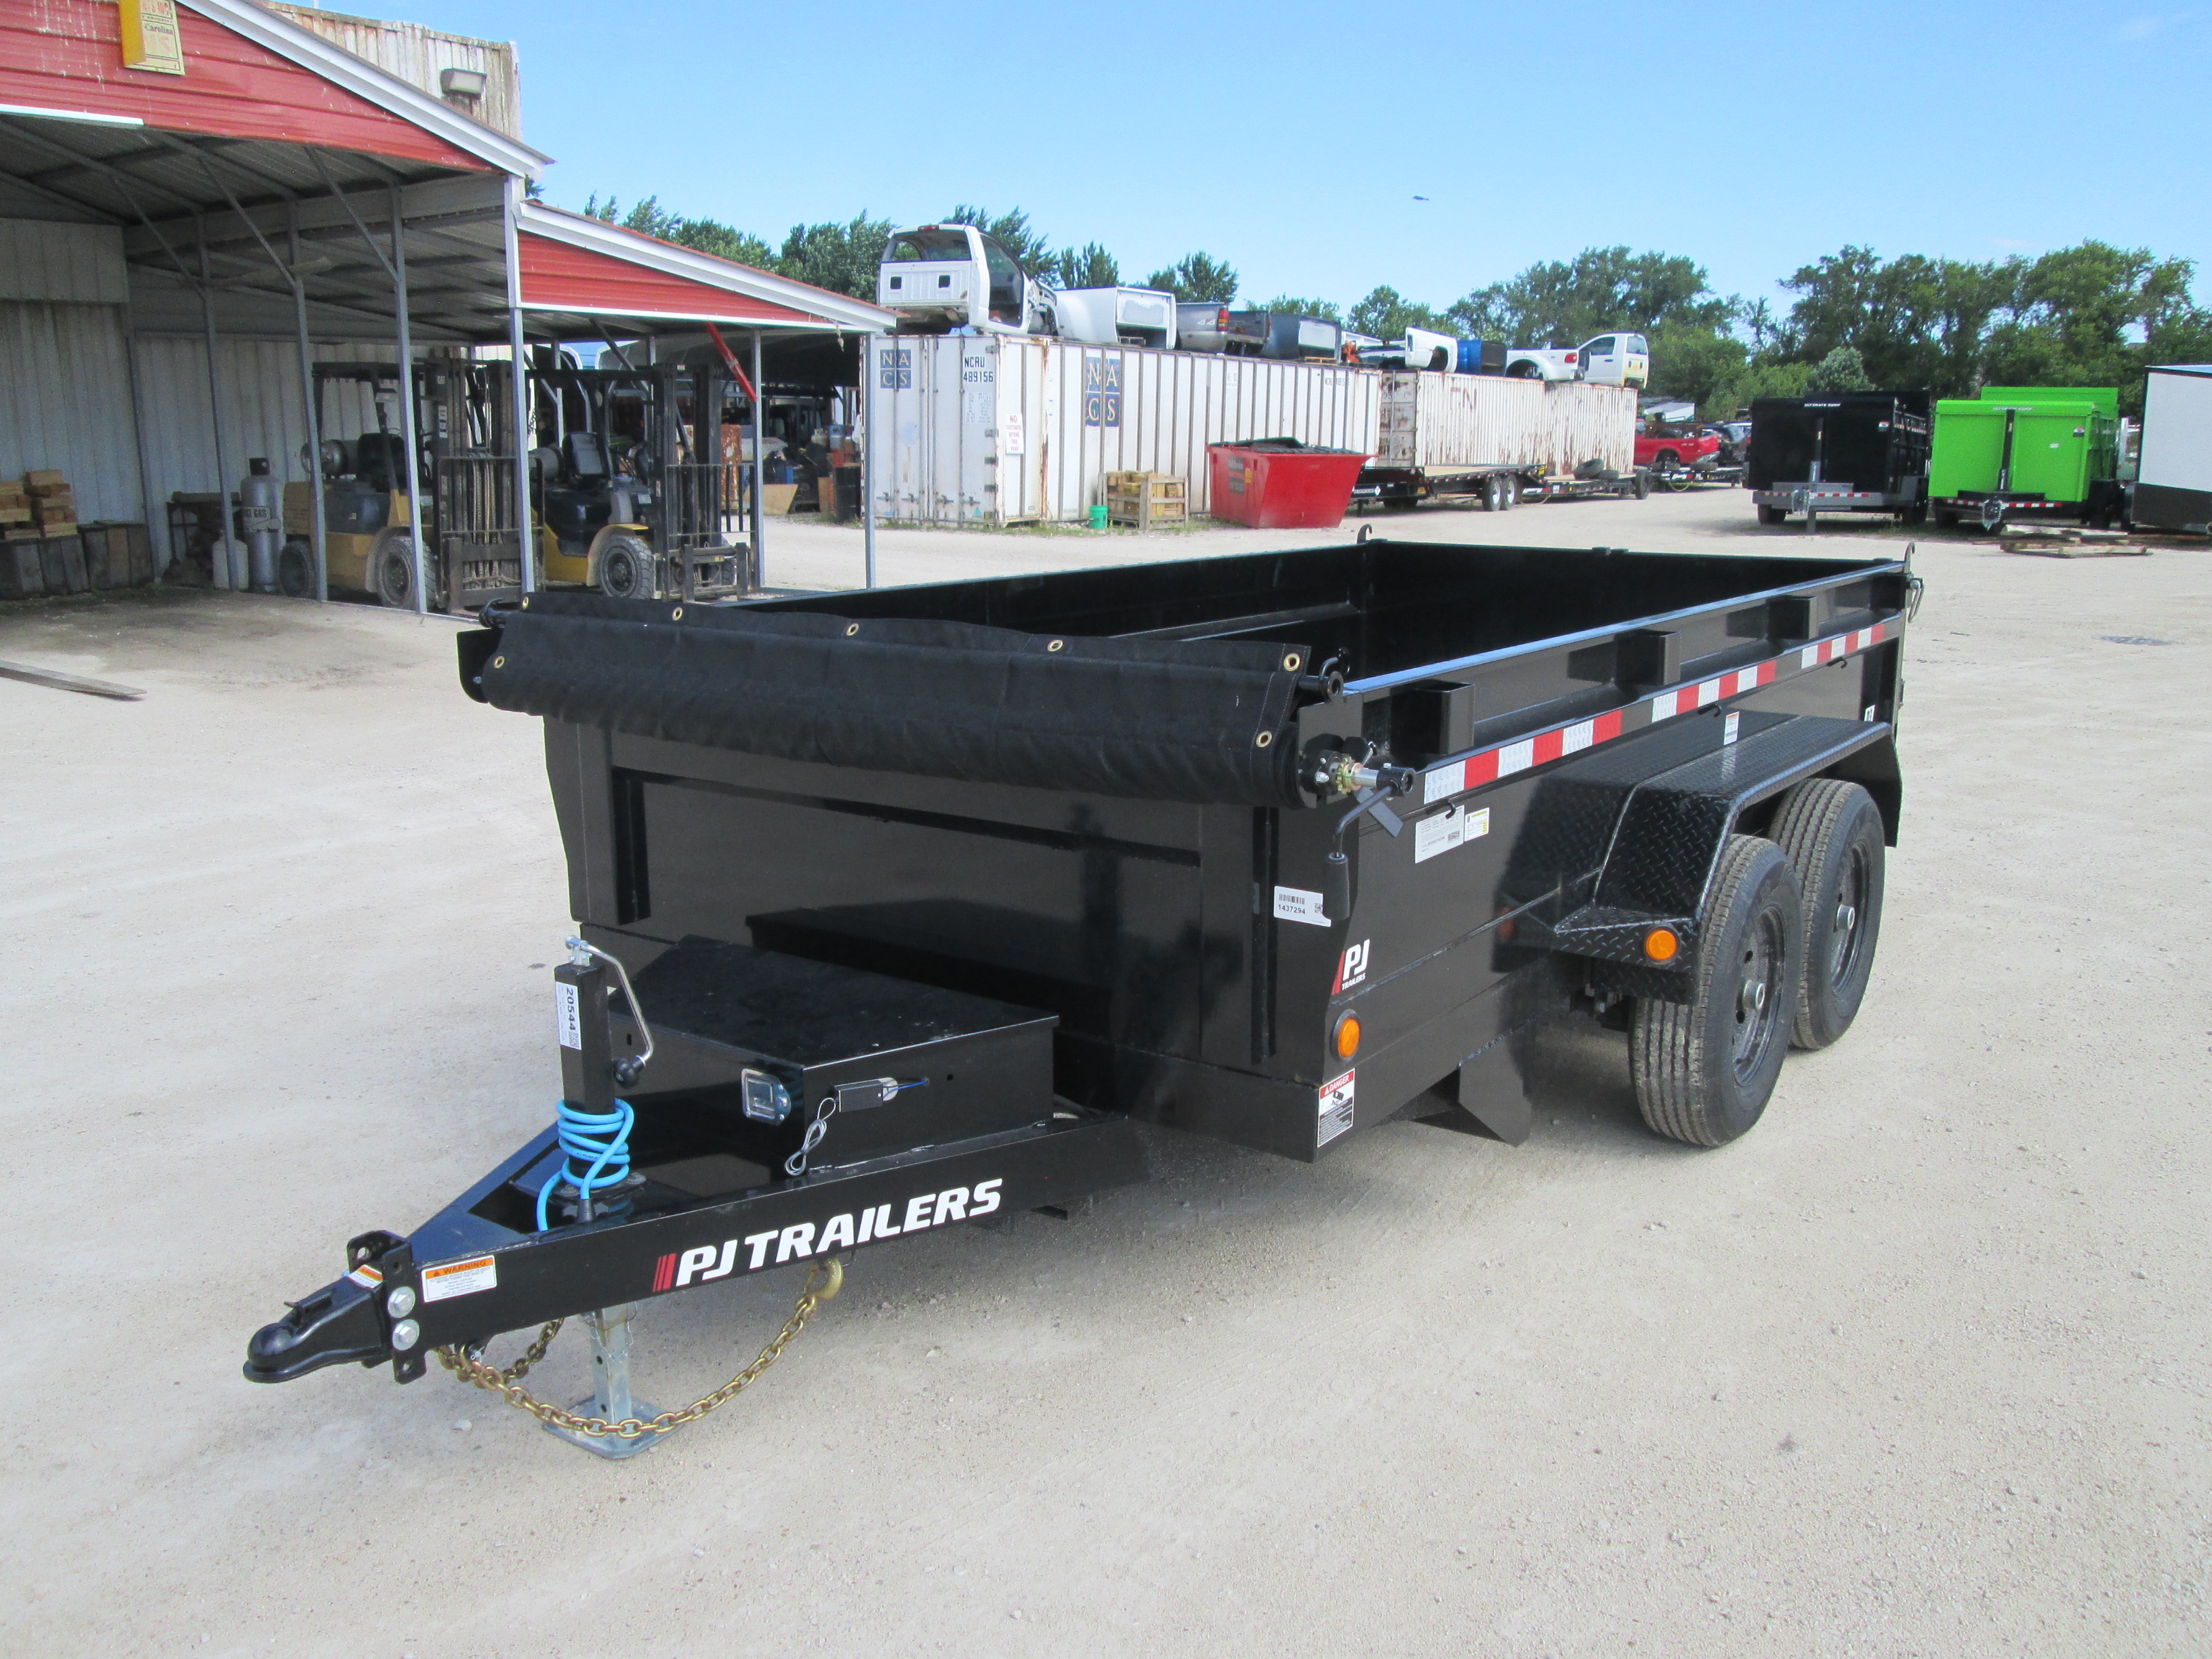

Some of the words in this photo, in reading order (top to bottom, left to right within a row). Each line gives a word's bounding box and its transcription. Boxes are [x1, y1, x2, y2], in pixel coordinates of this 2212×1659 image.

[963, 371, 994, 382] 489156
[1010, 415, 1017, 423] NO
[1278, 904, 1305, 914] 1437294
[1343, 939, 1370, 981] PJ
[1342, 972, 1366, 991] TRAILERS
[567, 987, 576, 1031] 20544
[1329, 1074, 1349, 1092] DANGER
[676, 1239, 738, 1287] PJ
[744, 1178, 1003, 1270] TRAILERS
[444, 1260, 487, 1274] WARNING
